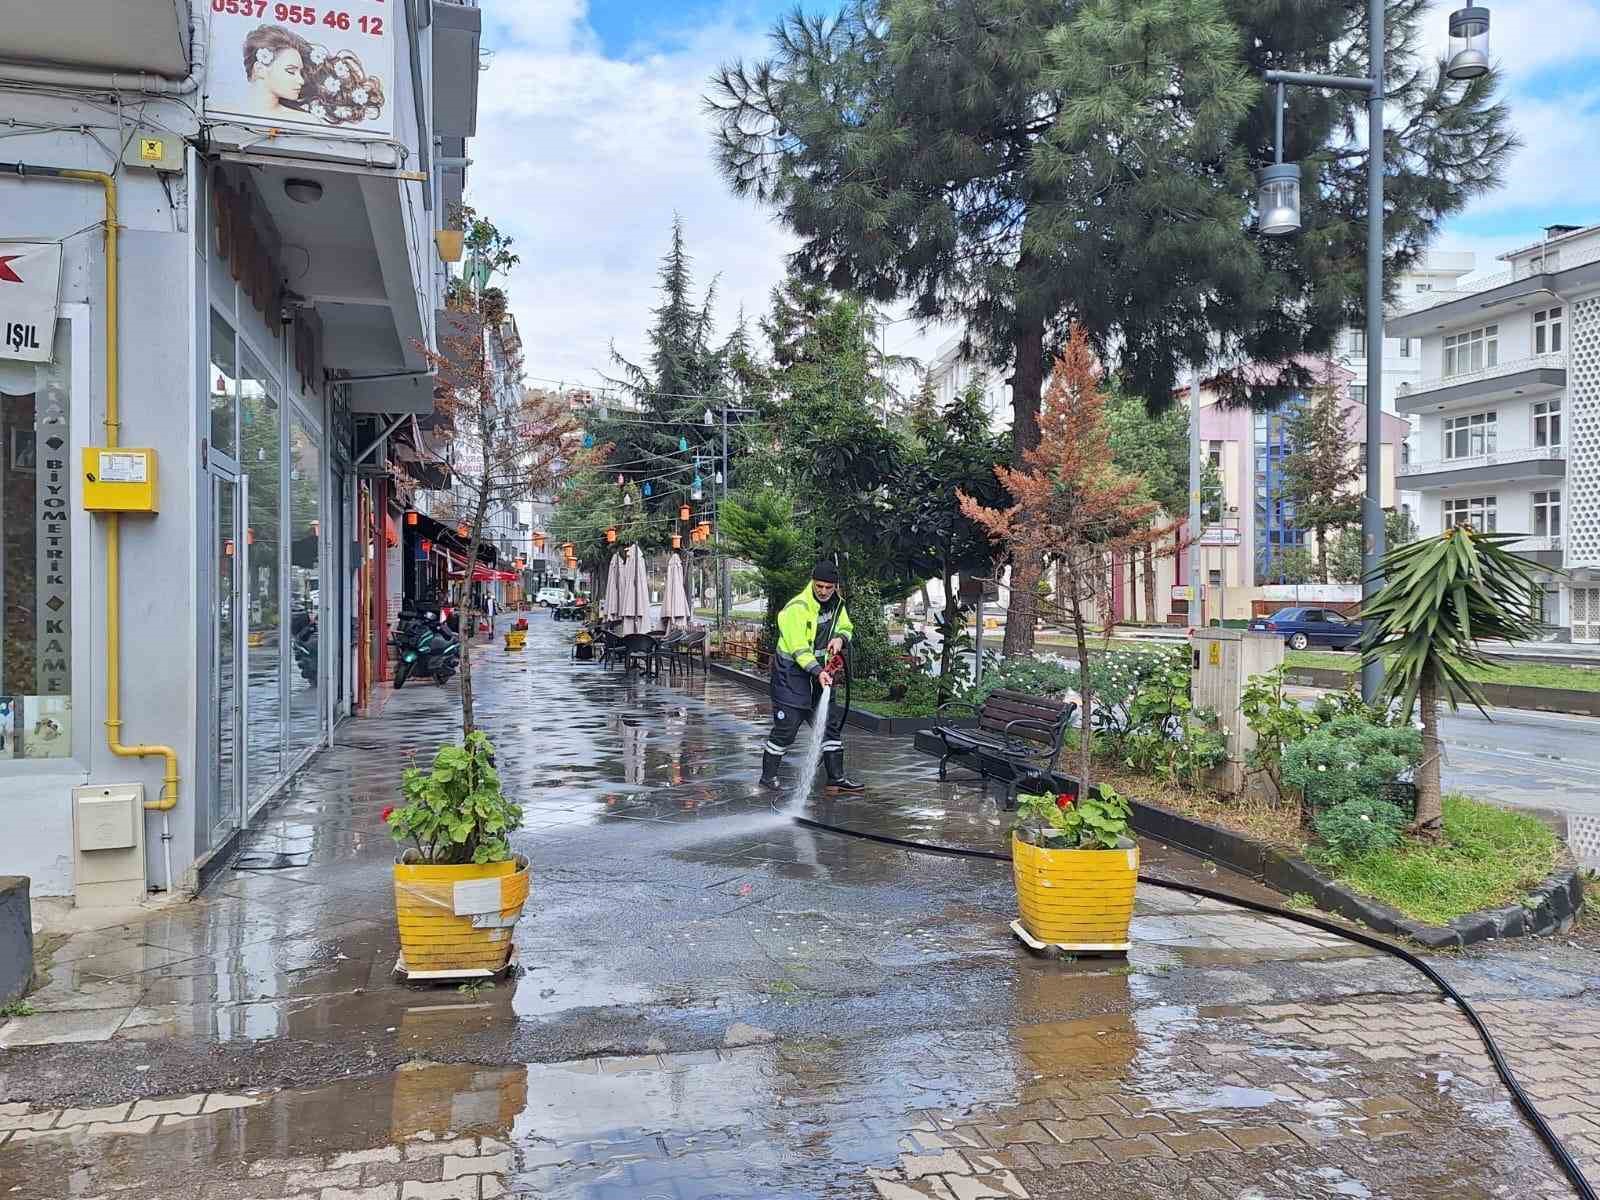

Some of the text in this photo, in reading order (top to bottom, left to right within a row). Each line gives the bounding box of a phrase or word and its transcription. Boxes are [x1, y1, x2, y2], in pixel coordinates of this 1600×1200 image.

[212, 0, 383, 35] 0537 955 46 12
[6, 322, 40, 352] IŞIL
